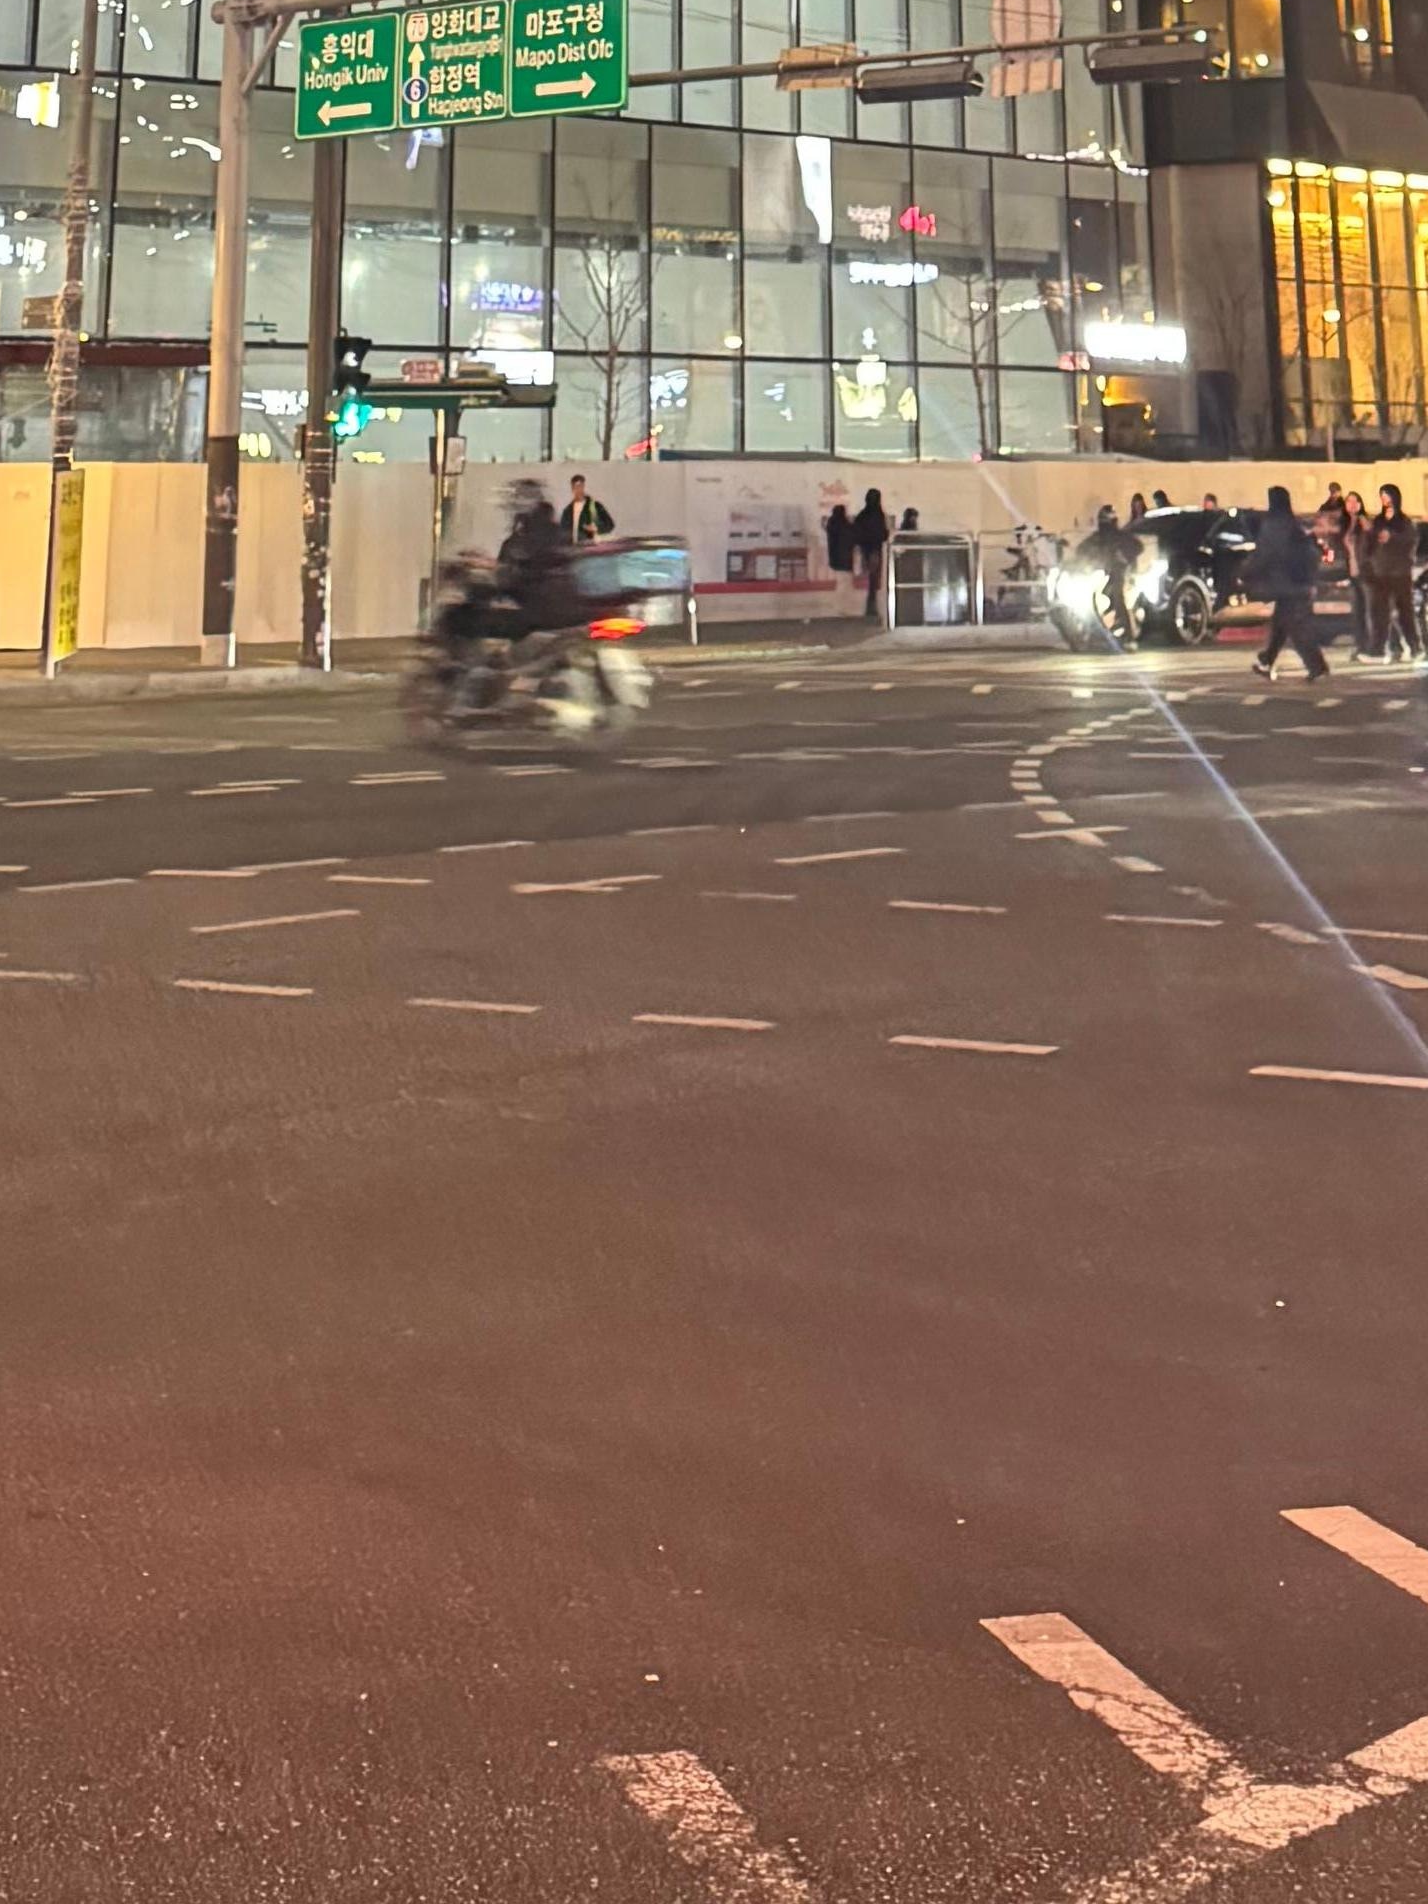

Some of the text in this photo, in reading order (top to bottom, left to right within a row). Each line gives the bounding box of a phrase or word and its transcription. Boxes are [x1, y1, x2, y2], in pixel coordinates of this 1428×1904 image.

[431, 5, 501, 39] 양화대교
[525, 0, 604, 40] 마포구청
[321, 29, 375, 64] 홍익대
[515, 47, 556, 70] Mapo
[558, 41, 586, 64] Dist
[588, 37, 614, 60] Ofc
[304, 62, 389, 92] Hongik Univ
[410, 80, 421, 101] 6
[429, 61, 481, 94] 합정역
